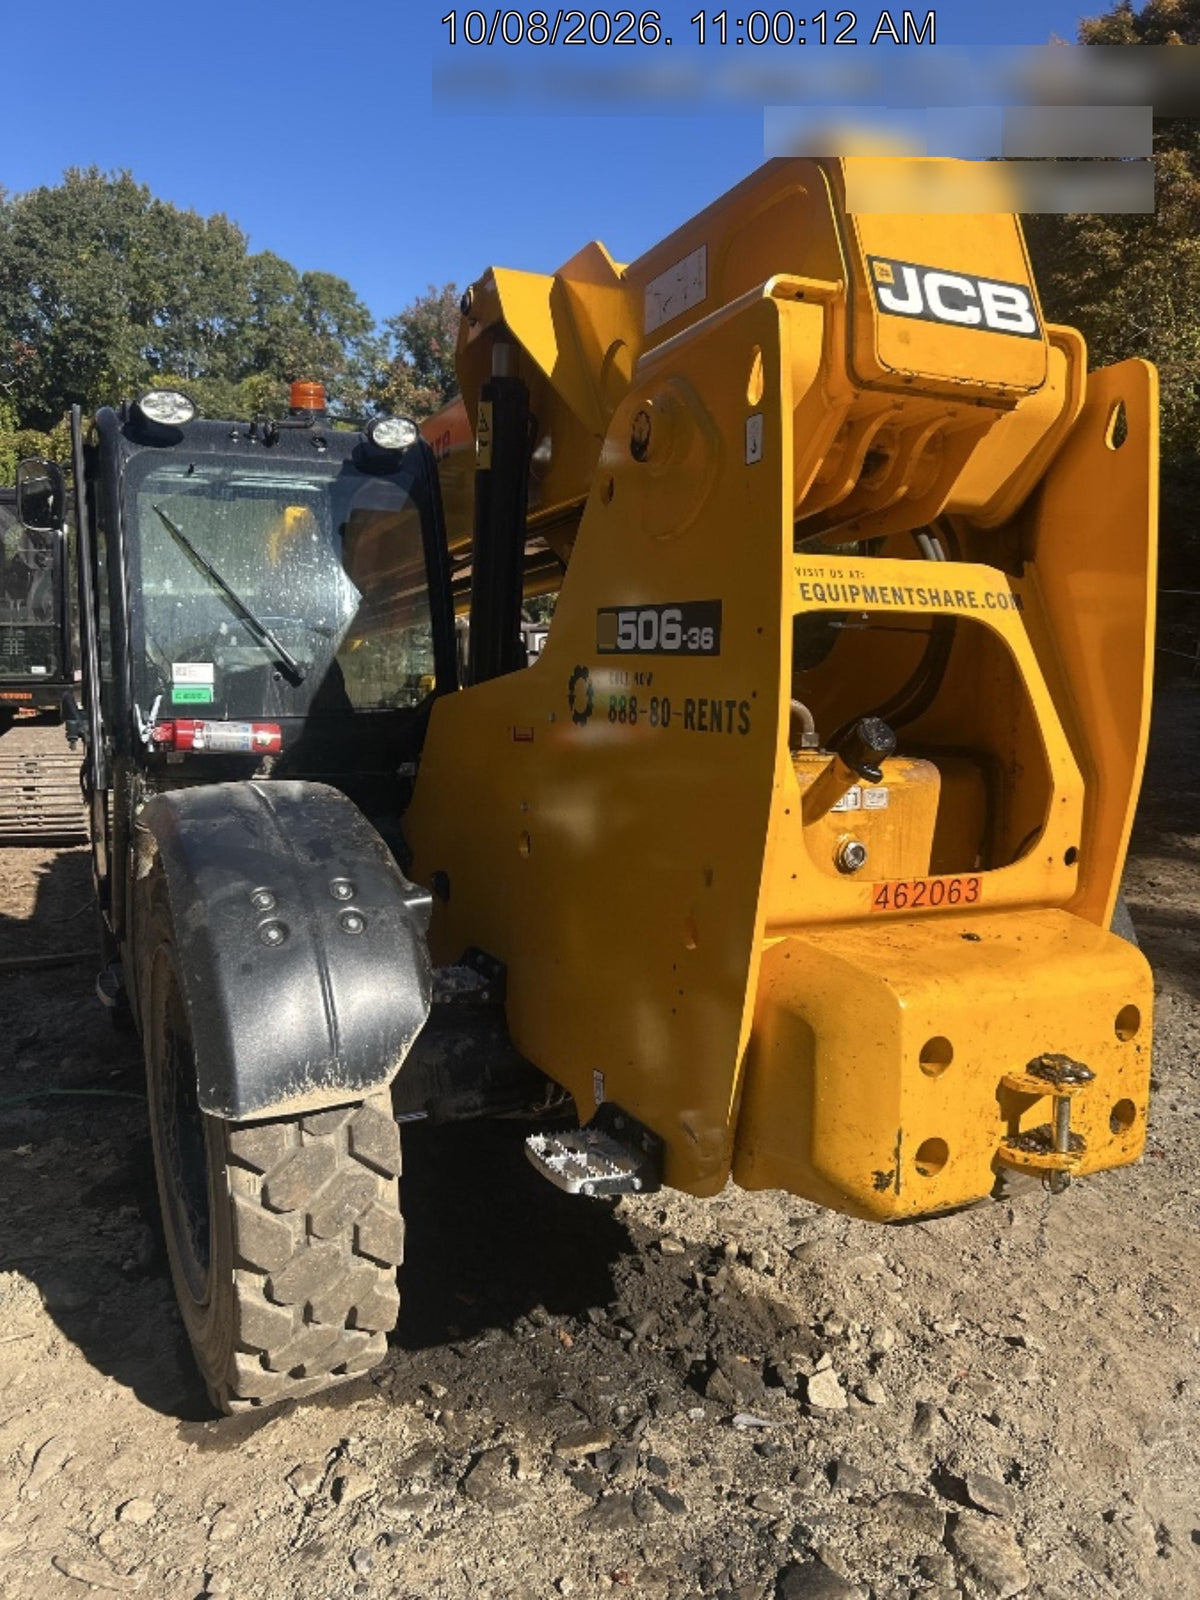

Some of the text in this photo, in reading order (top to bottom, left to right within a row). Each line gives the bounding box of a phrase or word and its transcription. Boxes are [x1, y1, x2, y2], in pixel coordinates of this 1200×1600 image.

[877, 266, 1037, 334] JCB
[794, 567, 825, 577] VISIT
[829, 570, 844, 578] US
[799, 582, 1024, 610] EQUIPMENTSHARE.COM
[617, 608, 714, 650] 506-36
[608, 694, 751, 735] 888-80-RENTS
[874, 877, 979, 909] 462063
